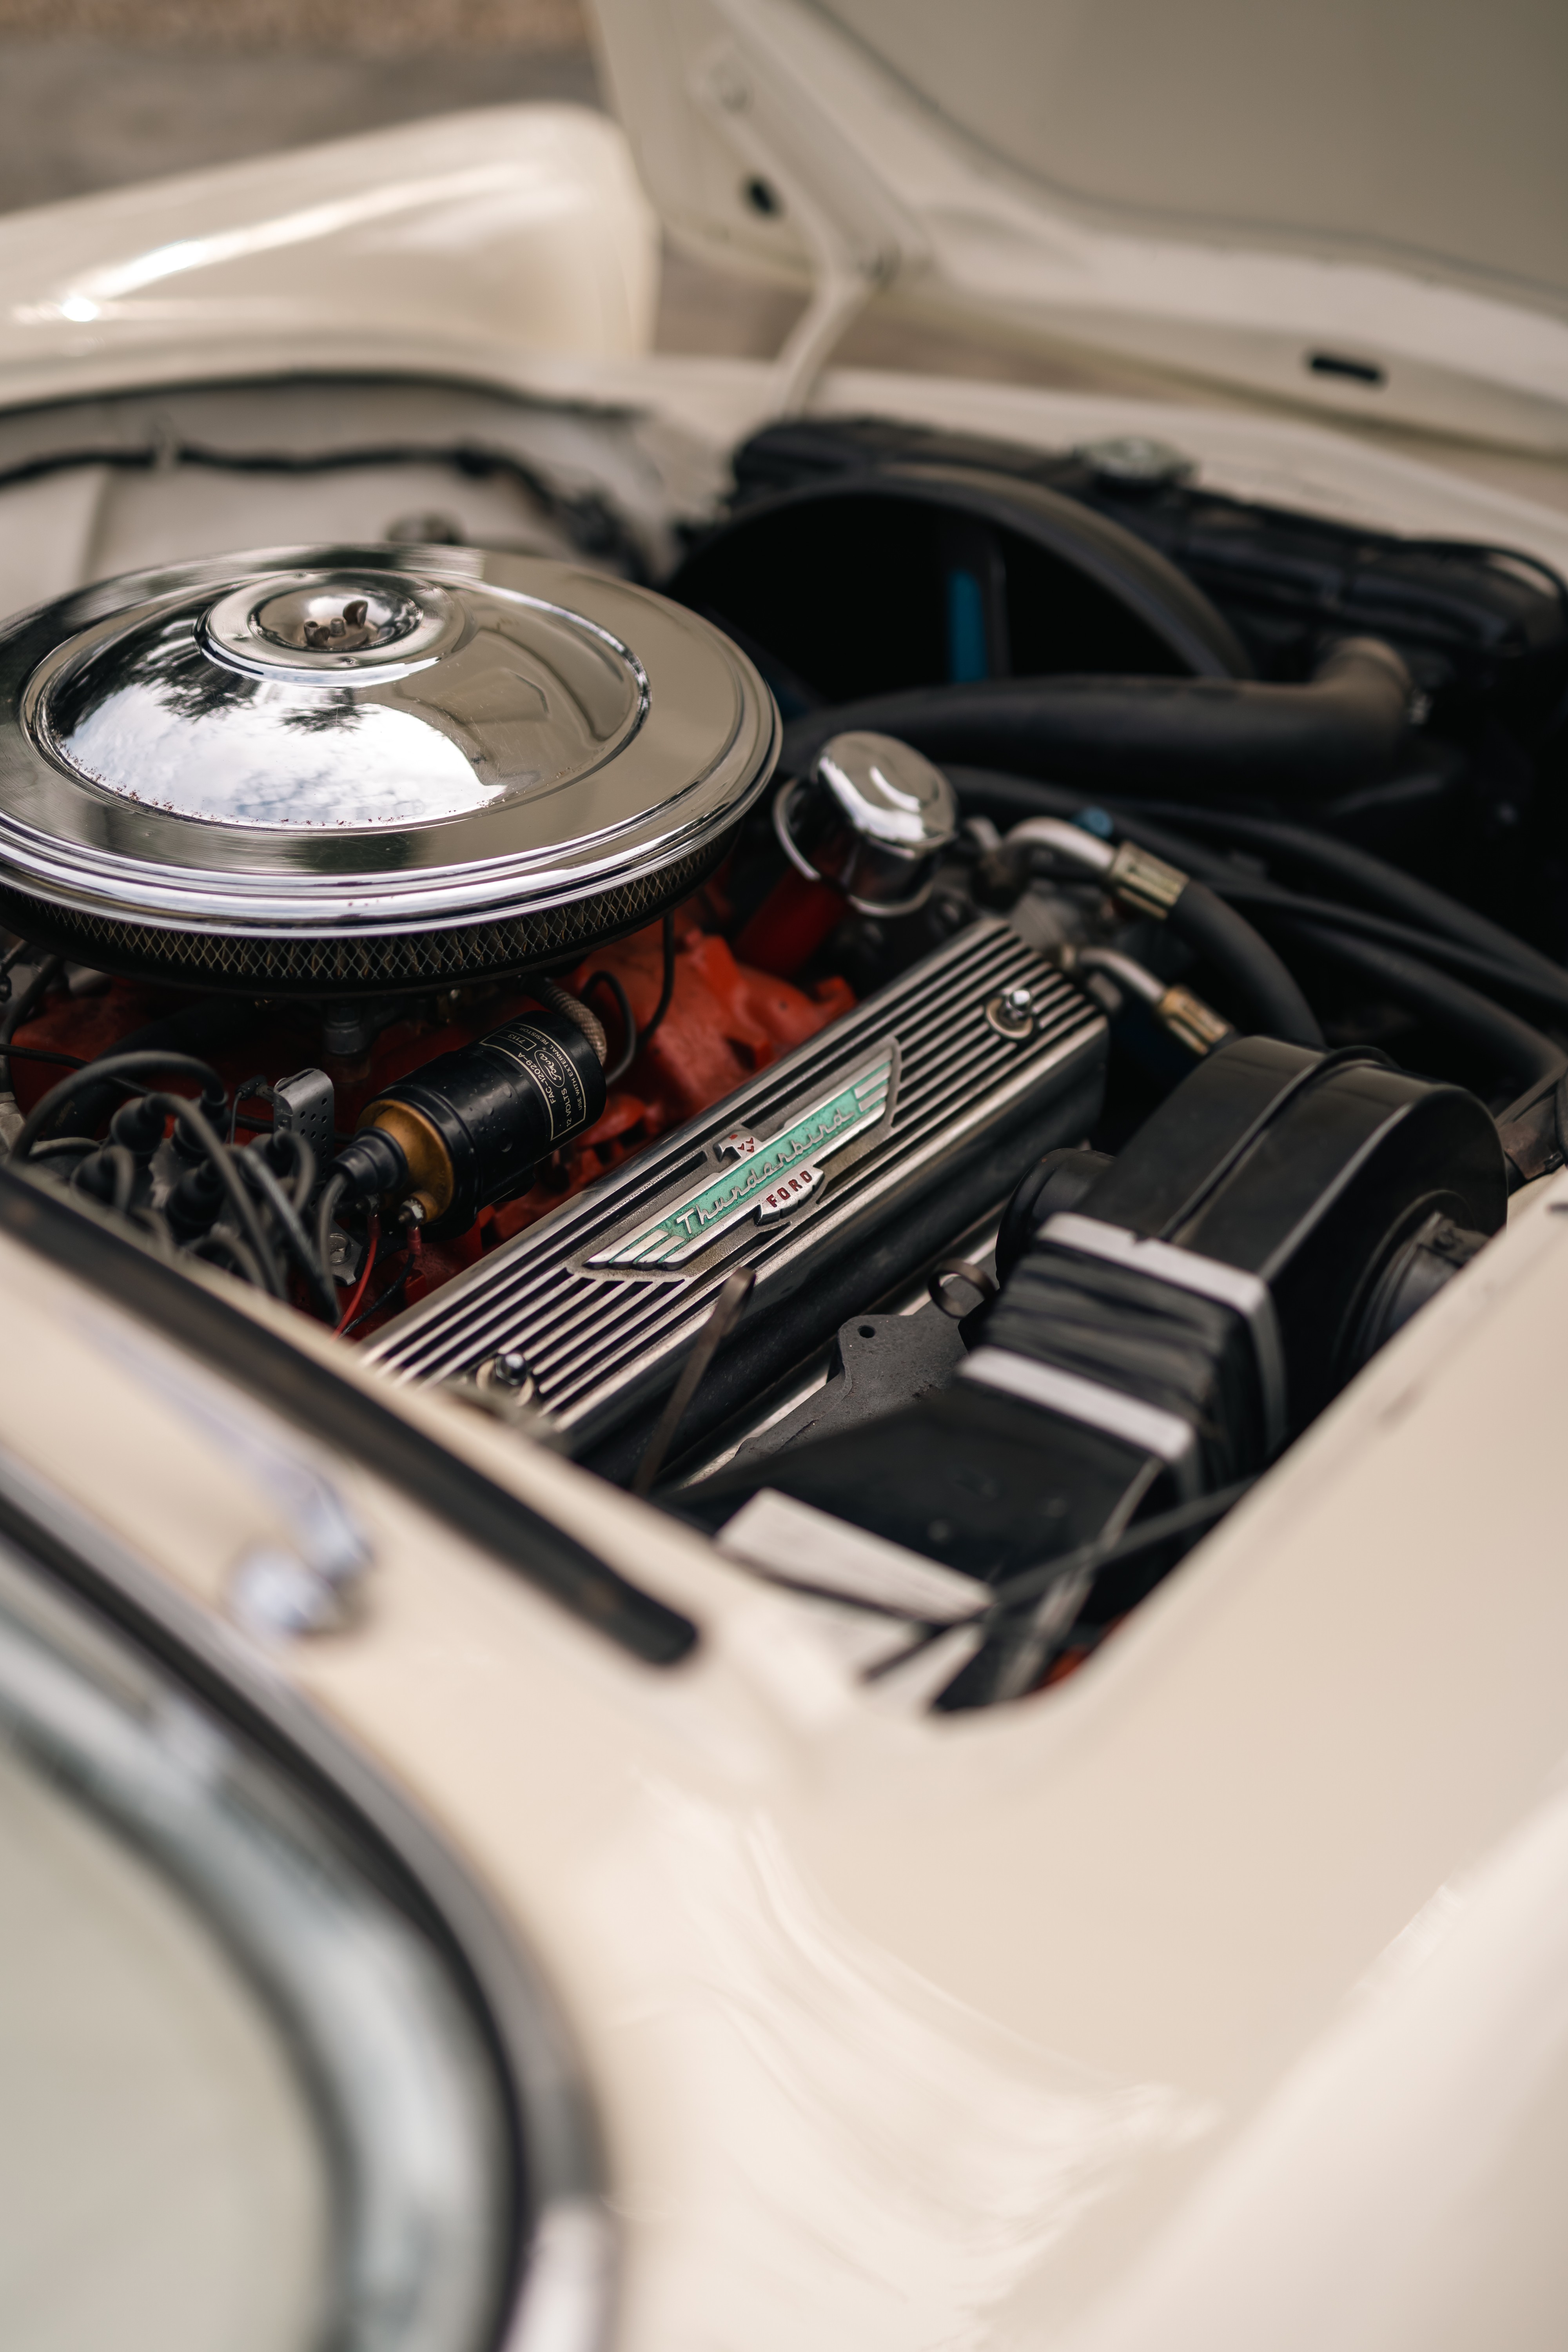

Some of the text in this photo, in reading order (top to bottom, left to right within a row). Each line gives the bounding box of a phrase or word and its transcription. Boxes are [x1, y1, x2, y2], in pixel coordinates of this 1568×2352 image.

[508, 1034, 525, 1044] 7113
[519, 1027, 549, 1045] RESISTOR
[518, 1052, 556, 1104] FAC-12029-A
[550, 1045, 573, 1077] EXTERNAL
[571, 1078, 580, 1096] WITH
[561, 1088, 572, 1127] 12 VOLTS
[675, 1108, 855, 1234] Thunderbird
[766, 1170, 813, 1208] FORD
